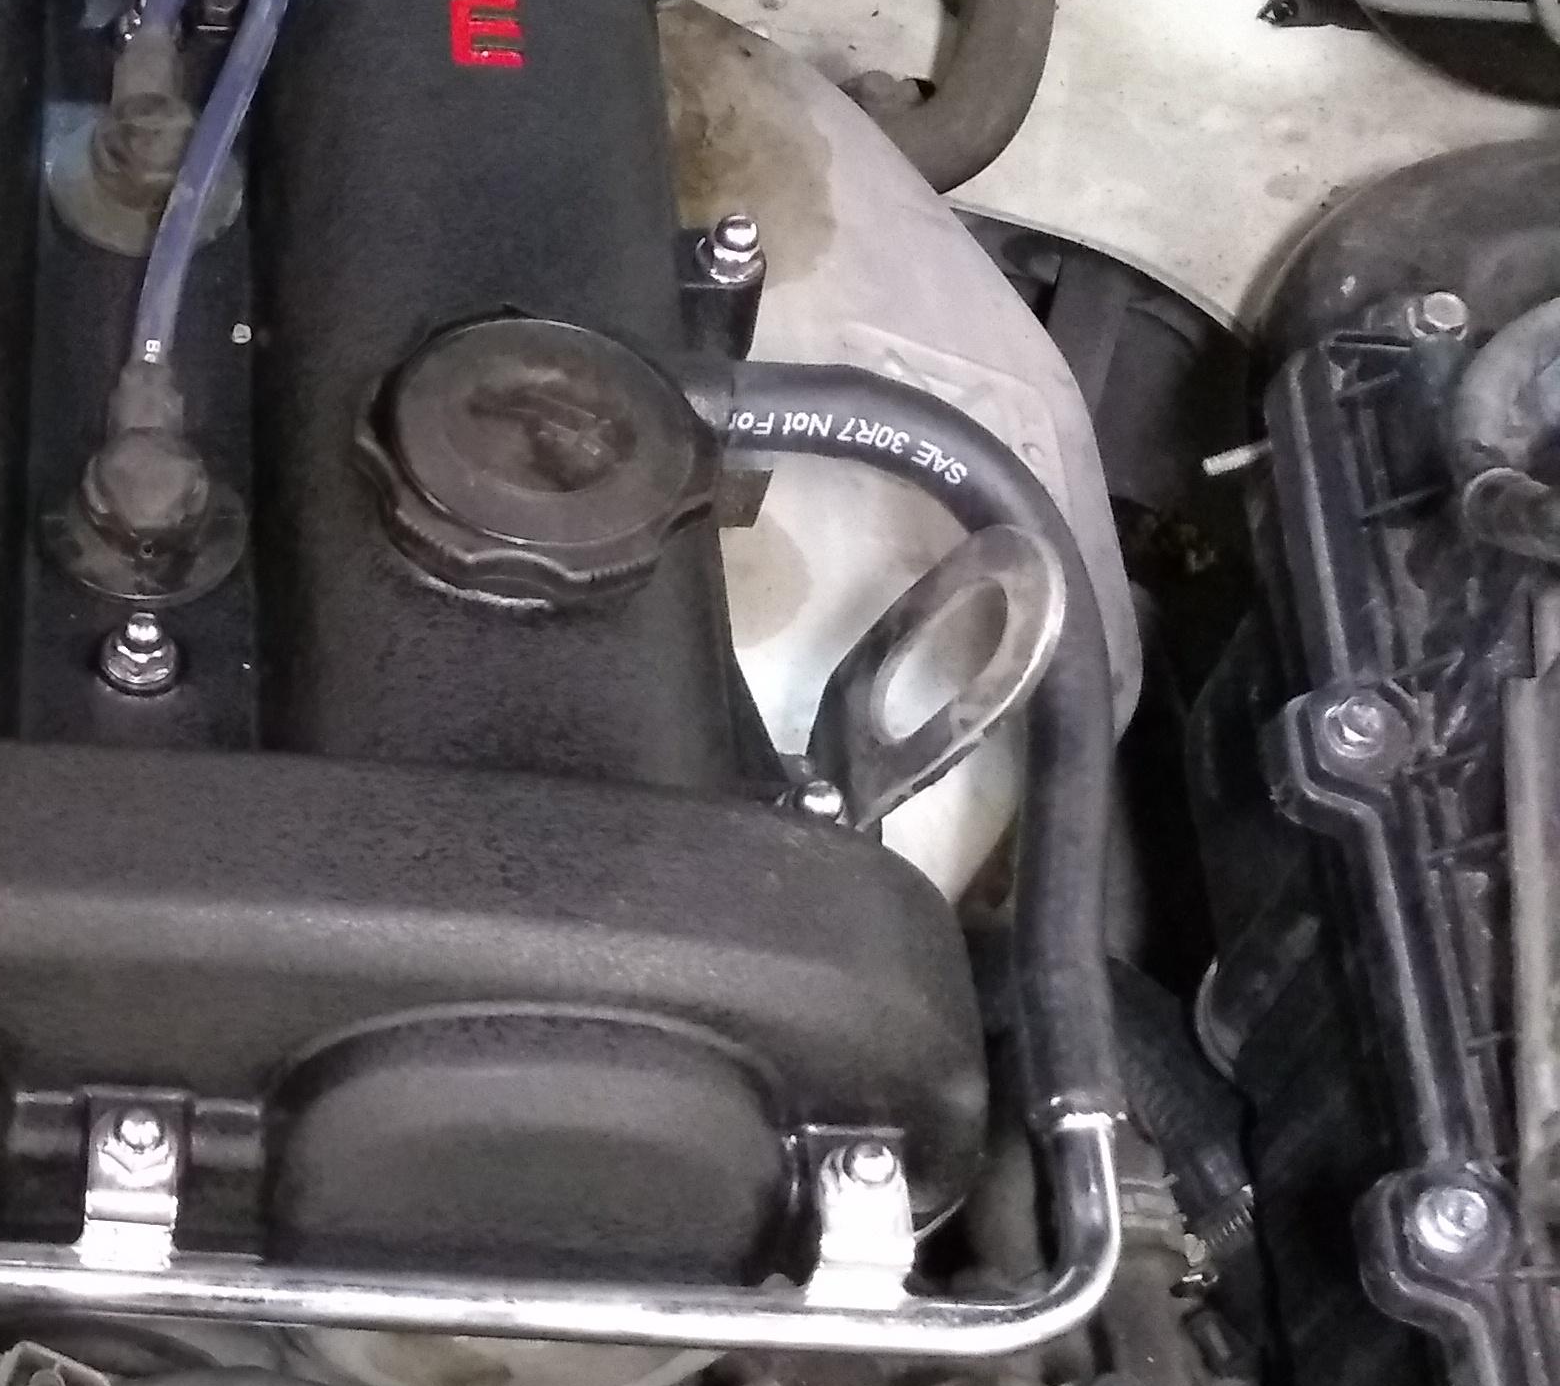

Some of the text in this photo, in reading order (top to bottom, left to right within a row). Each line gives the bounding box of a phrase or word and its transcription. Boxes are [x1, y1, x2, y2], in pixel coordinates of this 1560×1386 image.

[781, 411, 834, 438] Not
[836, 415, 910, 455] 30R7
[910, 439, 969, 486] SAE
